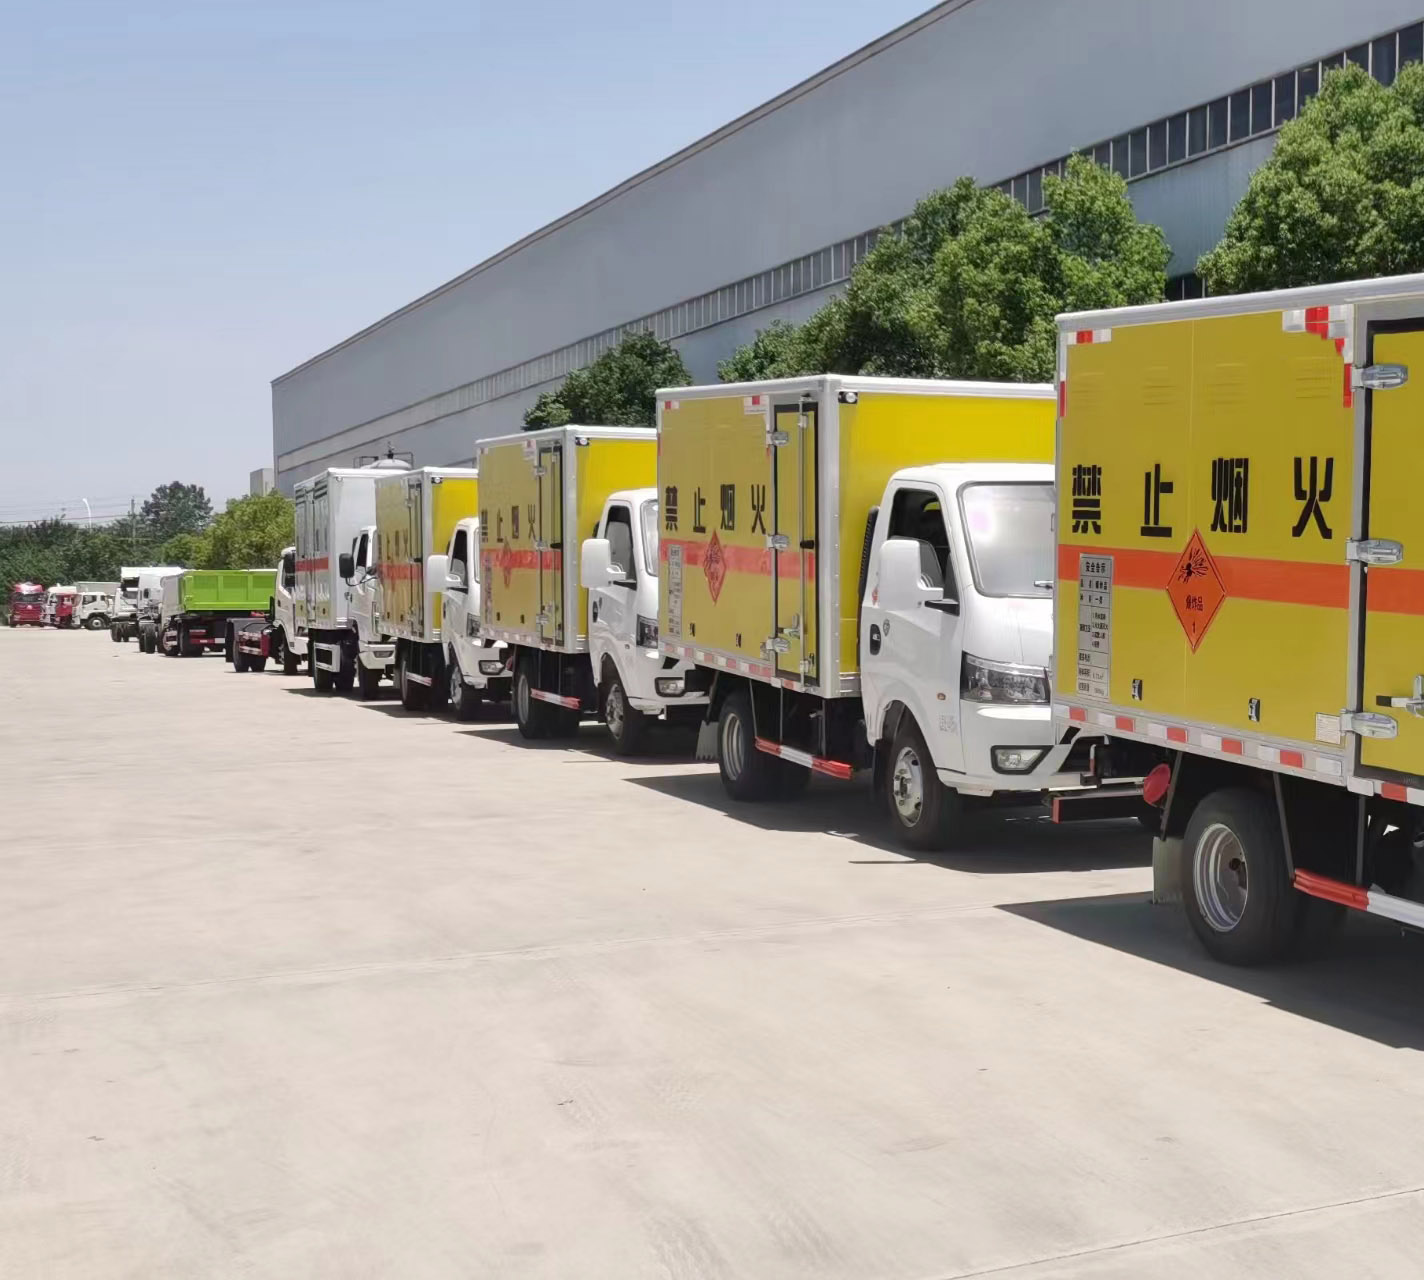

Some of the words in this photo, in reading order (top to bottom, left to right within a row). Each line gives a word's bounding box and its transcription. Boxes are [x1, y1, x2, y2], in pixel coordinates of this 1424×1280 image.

[665, 484, 767, 535] 禁止烟火
[1072, 456, 1334, 539] 禁止烟火
